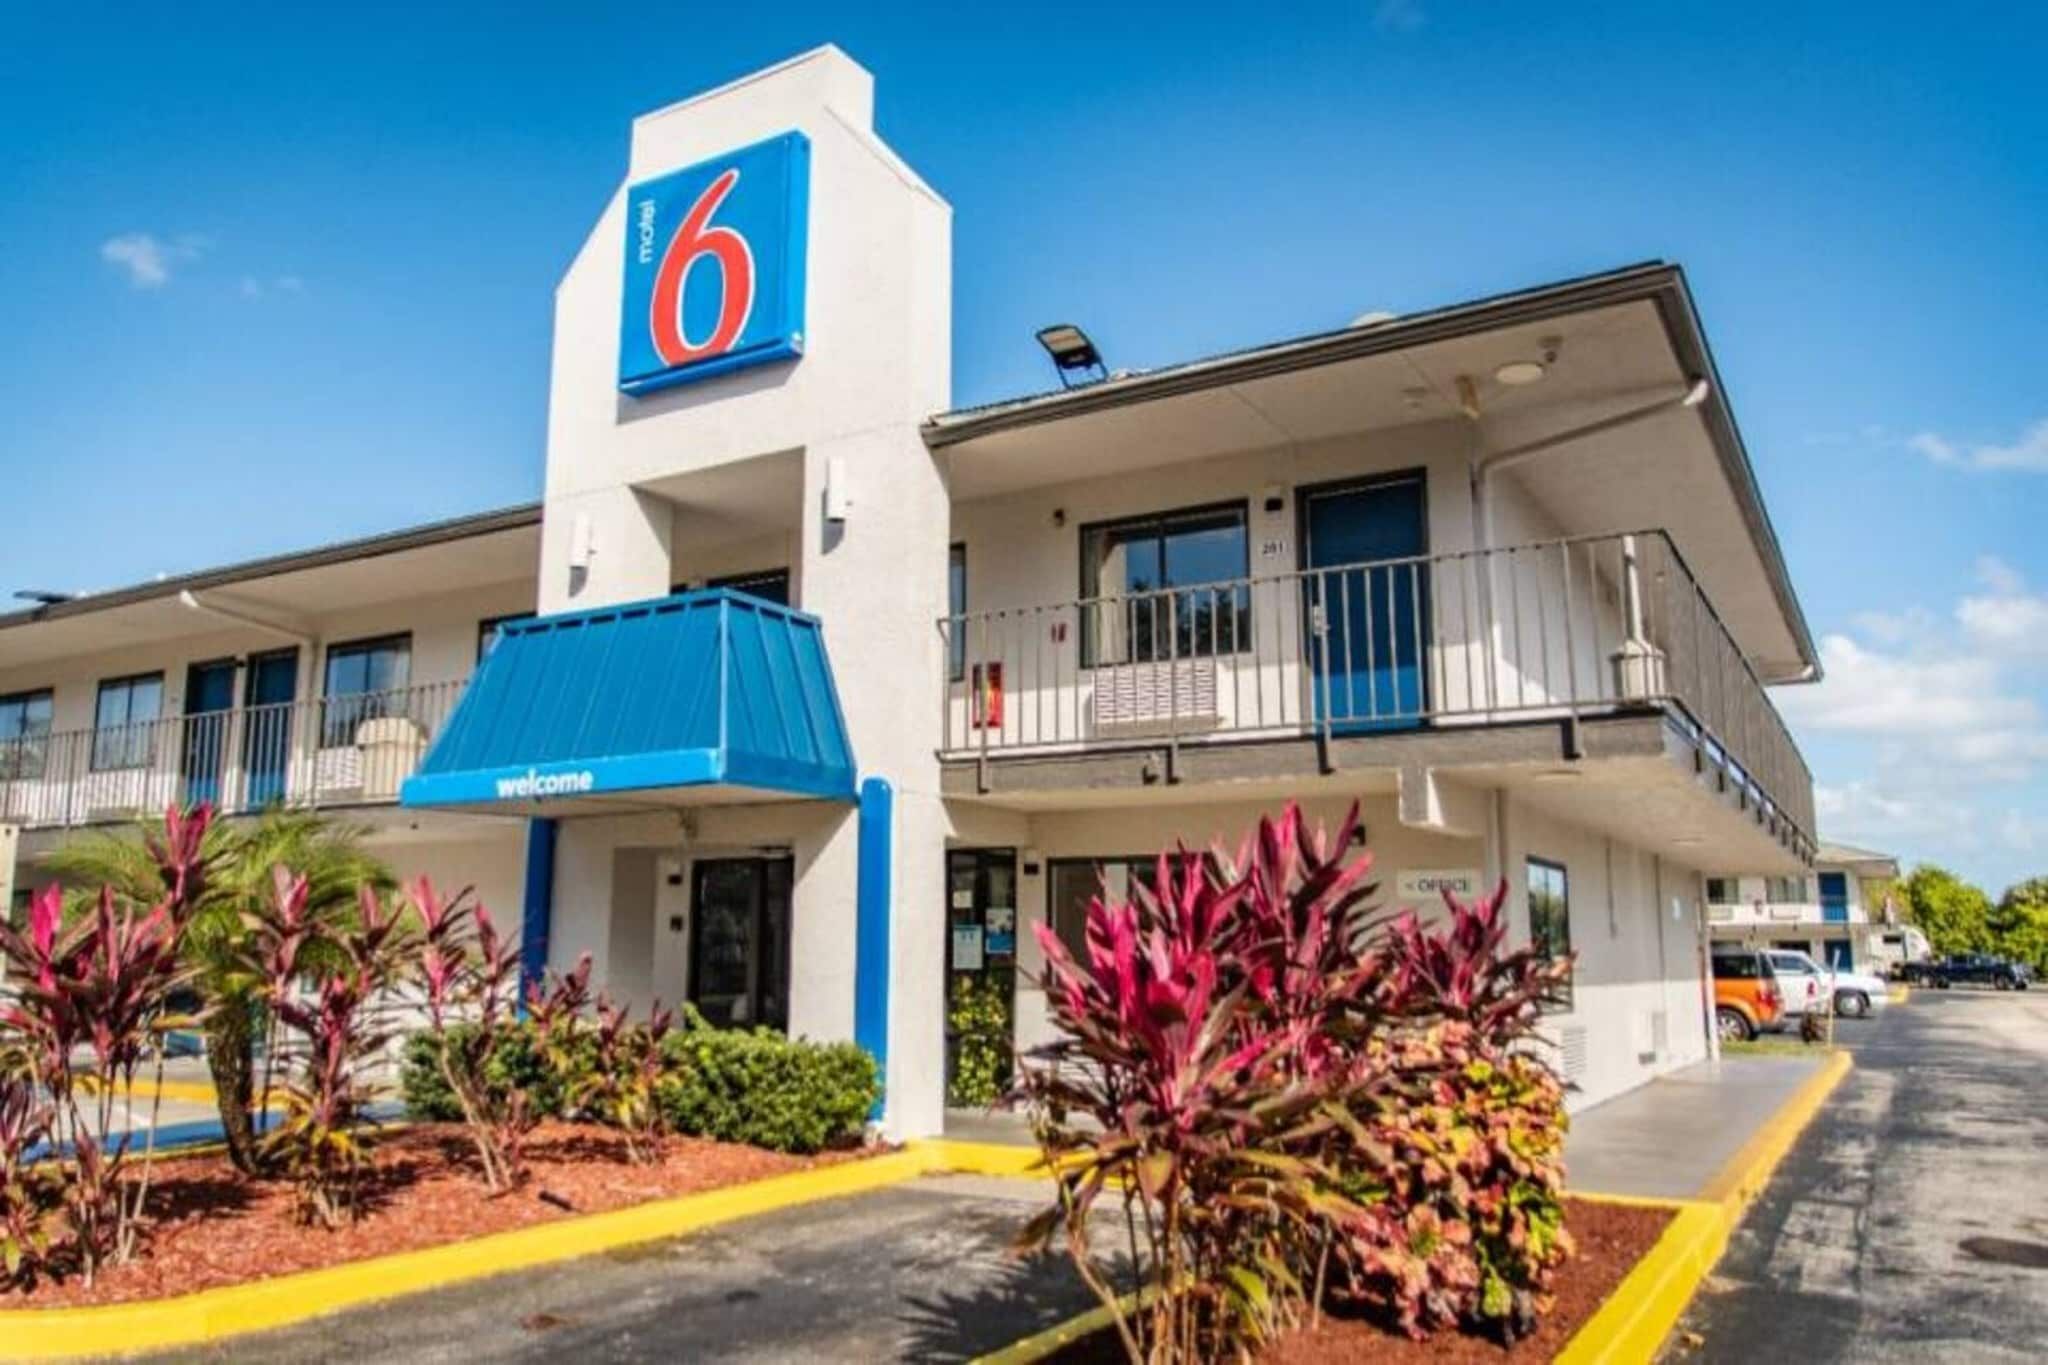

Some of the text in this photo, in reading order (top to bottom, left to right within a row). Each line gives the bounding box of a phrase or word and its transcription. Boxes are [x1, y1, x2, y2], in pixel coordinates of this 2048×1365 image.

[637, 199, 656, 264] motel
[650, 167, 756, 368] 6
[1262, 541, 1284, 555] 201
[496, 767, 594, 799] welcome
